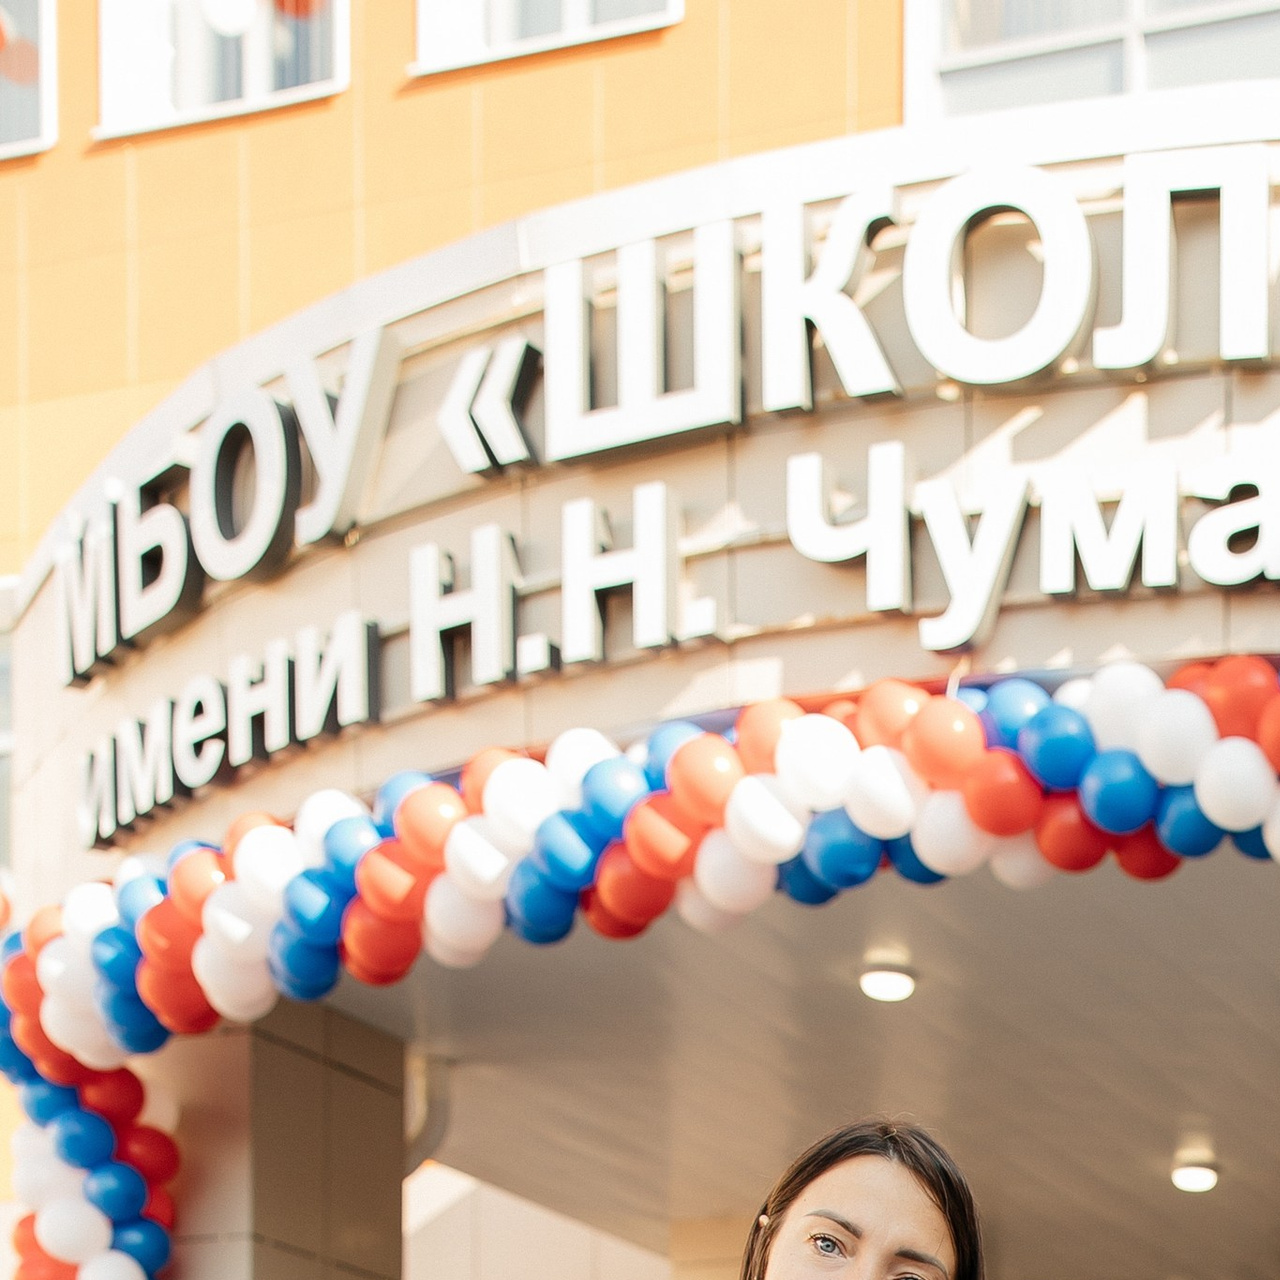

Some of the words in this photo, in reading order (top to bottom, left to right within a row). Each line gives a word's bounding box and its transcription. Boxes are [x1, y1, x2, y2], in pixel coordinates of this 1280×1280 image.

[54, 326, 386, 686] МБОУ
[78, 609, 369, 848] имени
[409, 481, 718, 703] Н.Н.
